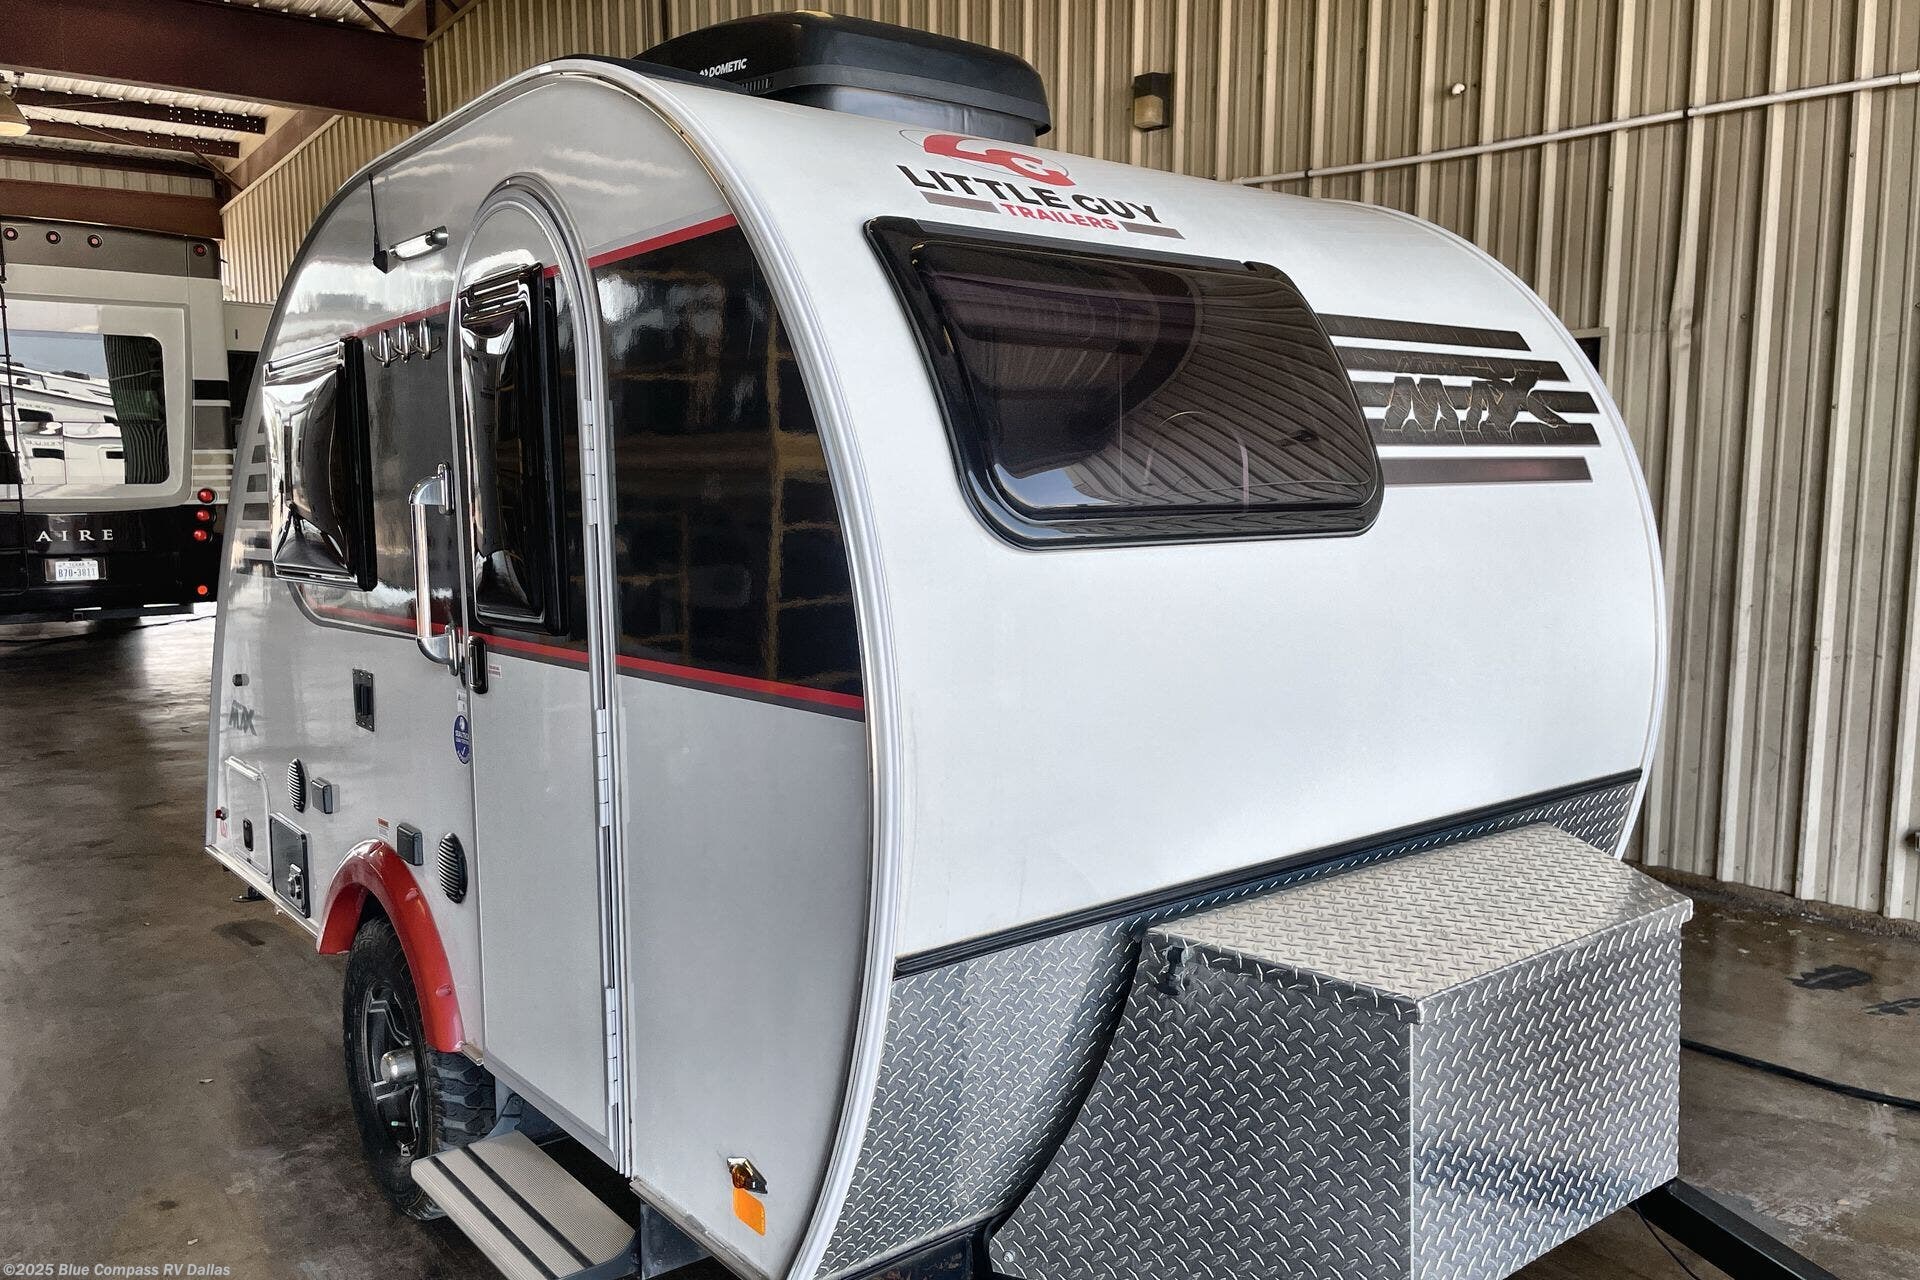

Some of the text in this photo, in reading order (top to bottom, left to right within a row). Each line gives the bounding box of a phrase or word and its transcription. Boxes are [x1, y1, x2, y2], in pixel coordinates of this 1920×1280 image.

[709, 58, 748, 78] DOMETIC
[896, 164, 1162, 224] LITTLE GUY
[1000, 203, 1120, 231] TRAILERS
[35, 529, 114, 542] AIRE
